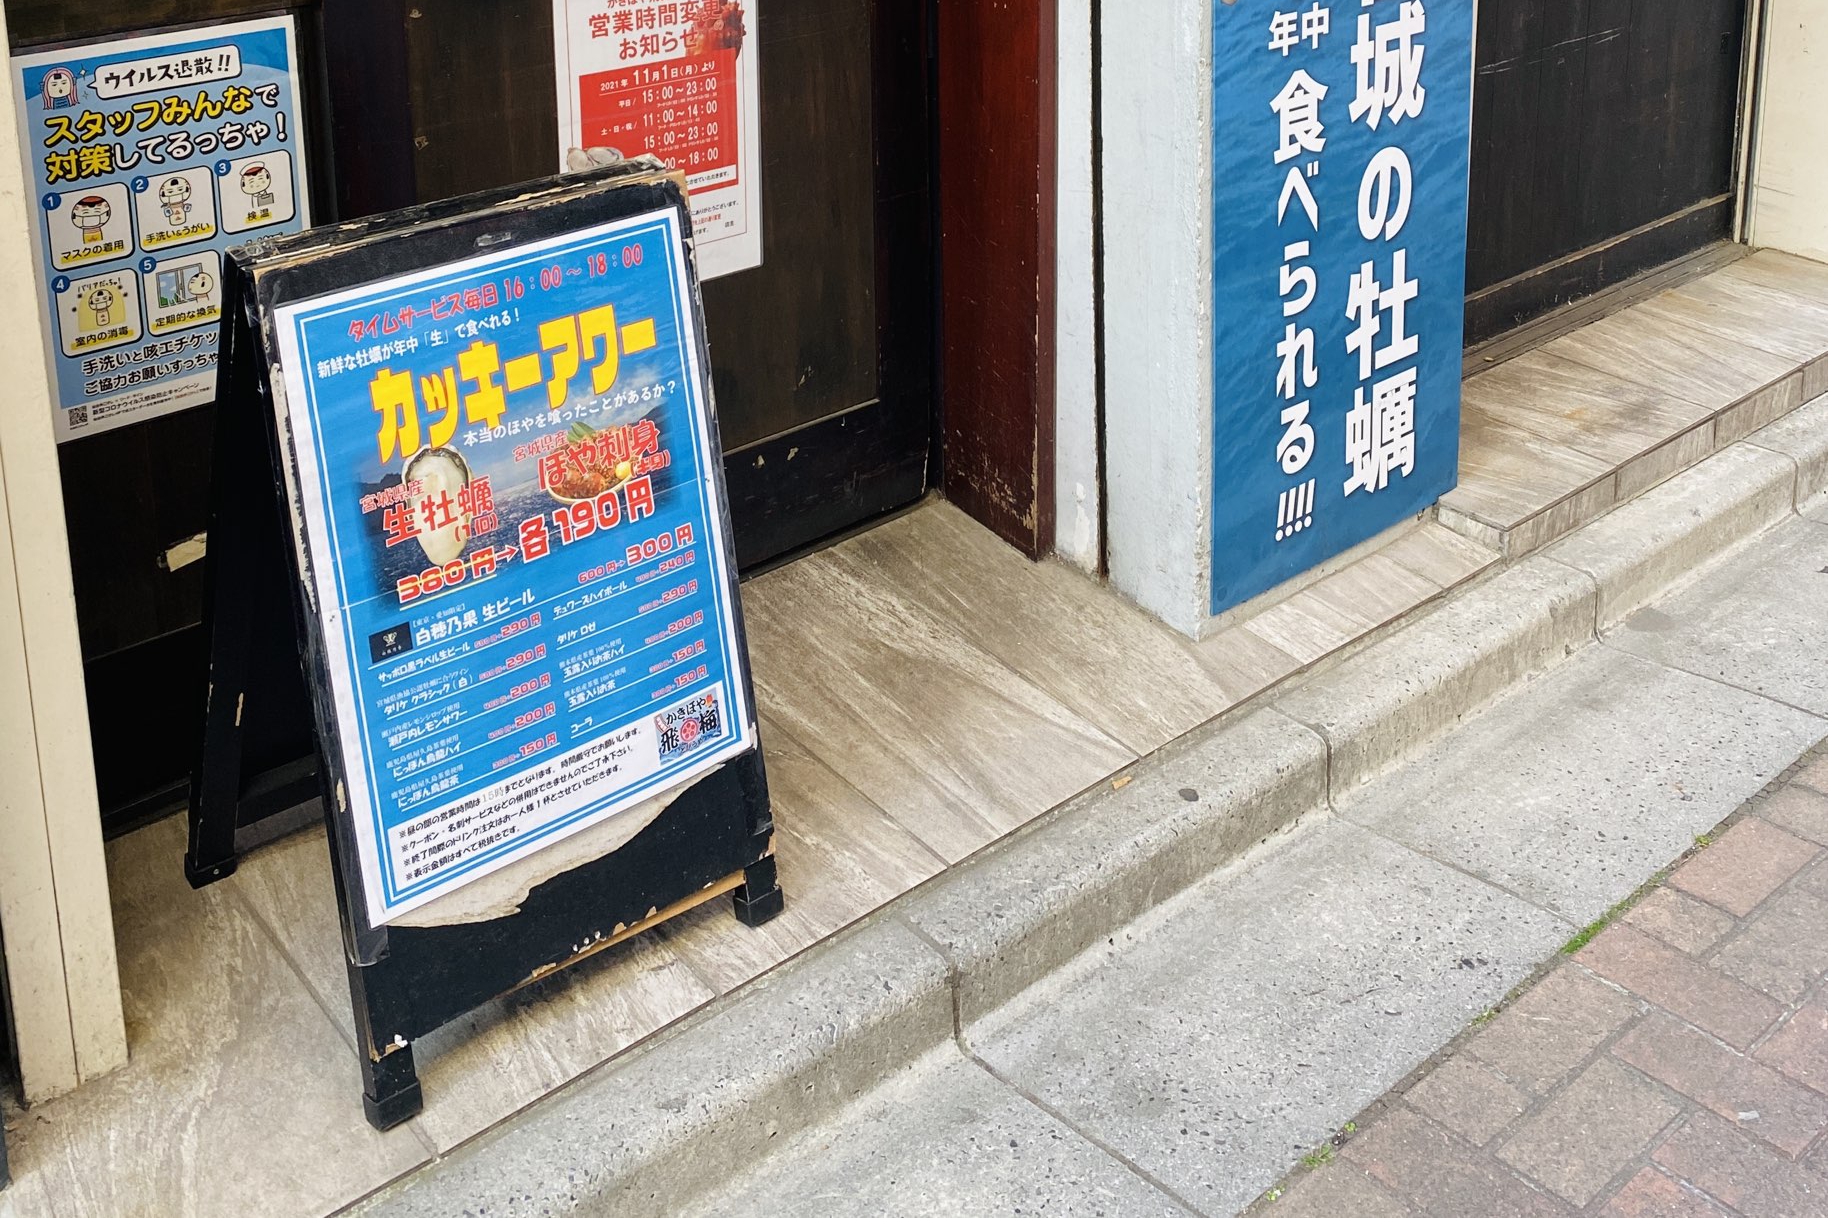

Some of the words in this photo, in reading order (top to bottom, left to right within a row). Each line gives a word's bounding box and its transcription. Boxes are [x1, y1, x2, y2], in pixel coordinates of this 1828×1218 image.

[619, 28, 701, 61] お知らせ
[44, 84, 280, 148] スタッフみんなで
[600, 79, 628, 91] 2021年
[45, 112, 287, 183] 対策してるっちゃ！
[61, 240, 125, 260] マスクの着用
[145, 222, 210, 244] 手洗い&うがい
[75, 326, 129, 348] 室内の消毒
[155, 305, 217, 328] 定期的な換気
[347, 283, 498, 343] タイムサービス毎日
[370, 303, 658, 465] カッキーアワー
[463, 380, 677, 448] 本当のほやを喰ったことがあるか？
[511, 429, 569, 463] 宮城県産
[536, 419, 661, 490] ほや刺身
[359, 477, 425, 514] 宮城県産
[381, 475, 495, 548] 生牡蠣
[517, 475, 656, 564] 各190円
[415, 609, 479, 647] 白穂乃果
[482, 588, 536, 622] 生ビール
[577, 560, 617, 584] 600円
[625, 522, 694, 566] 300円
[658, 550, 695, 574] 240円
[661, 579, 698, 604] 290円
[378, 641, 471, 682] サッポロ黒ラベル生ビール
[501, 611, 542, 638] 290円
[505, 643, 547, 669] 290円
[562, 644, 626, 679] 玉露入りお茶ハイ
[667, 609, 704, 635] 200円
[567, 679, 617, 709] 玉露入りお茶
[671, 638, 706, 663] 150円
[388, 710, 468, 749] 瀬戸内レモンサワー
[509, 672, 551, 700] 200円
[570, 715, 594, 735] コーラ
[673, 664, 708, 688] 150円
[666, 697, 707, 726] かきほや
[393, 740, 462, 778] にっぽん烏龍ハイ
[514, 701, 556, 728] 200円
[660, 710, 718, 755] 飛梅
[397, 774, 460, 809] にっぽん烏龍茶
[518, 731, 558, 758] 150円
